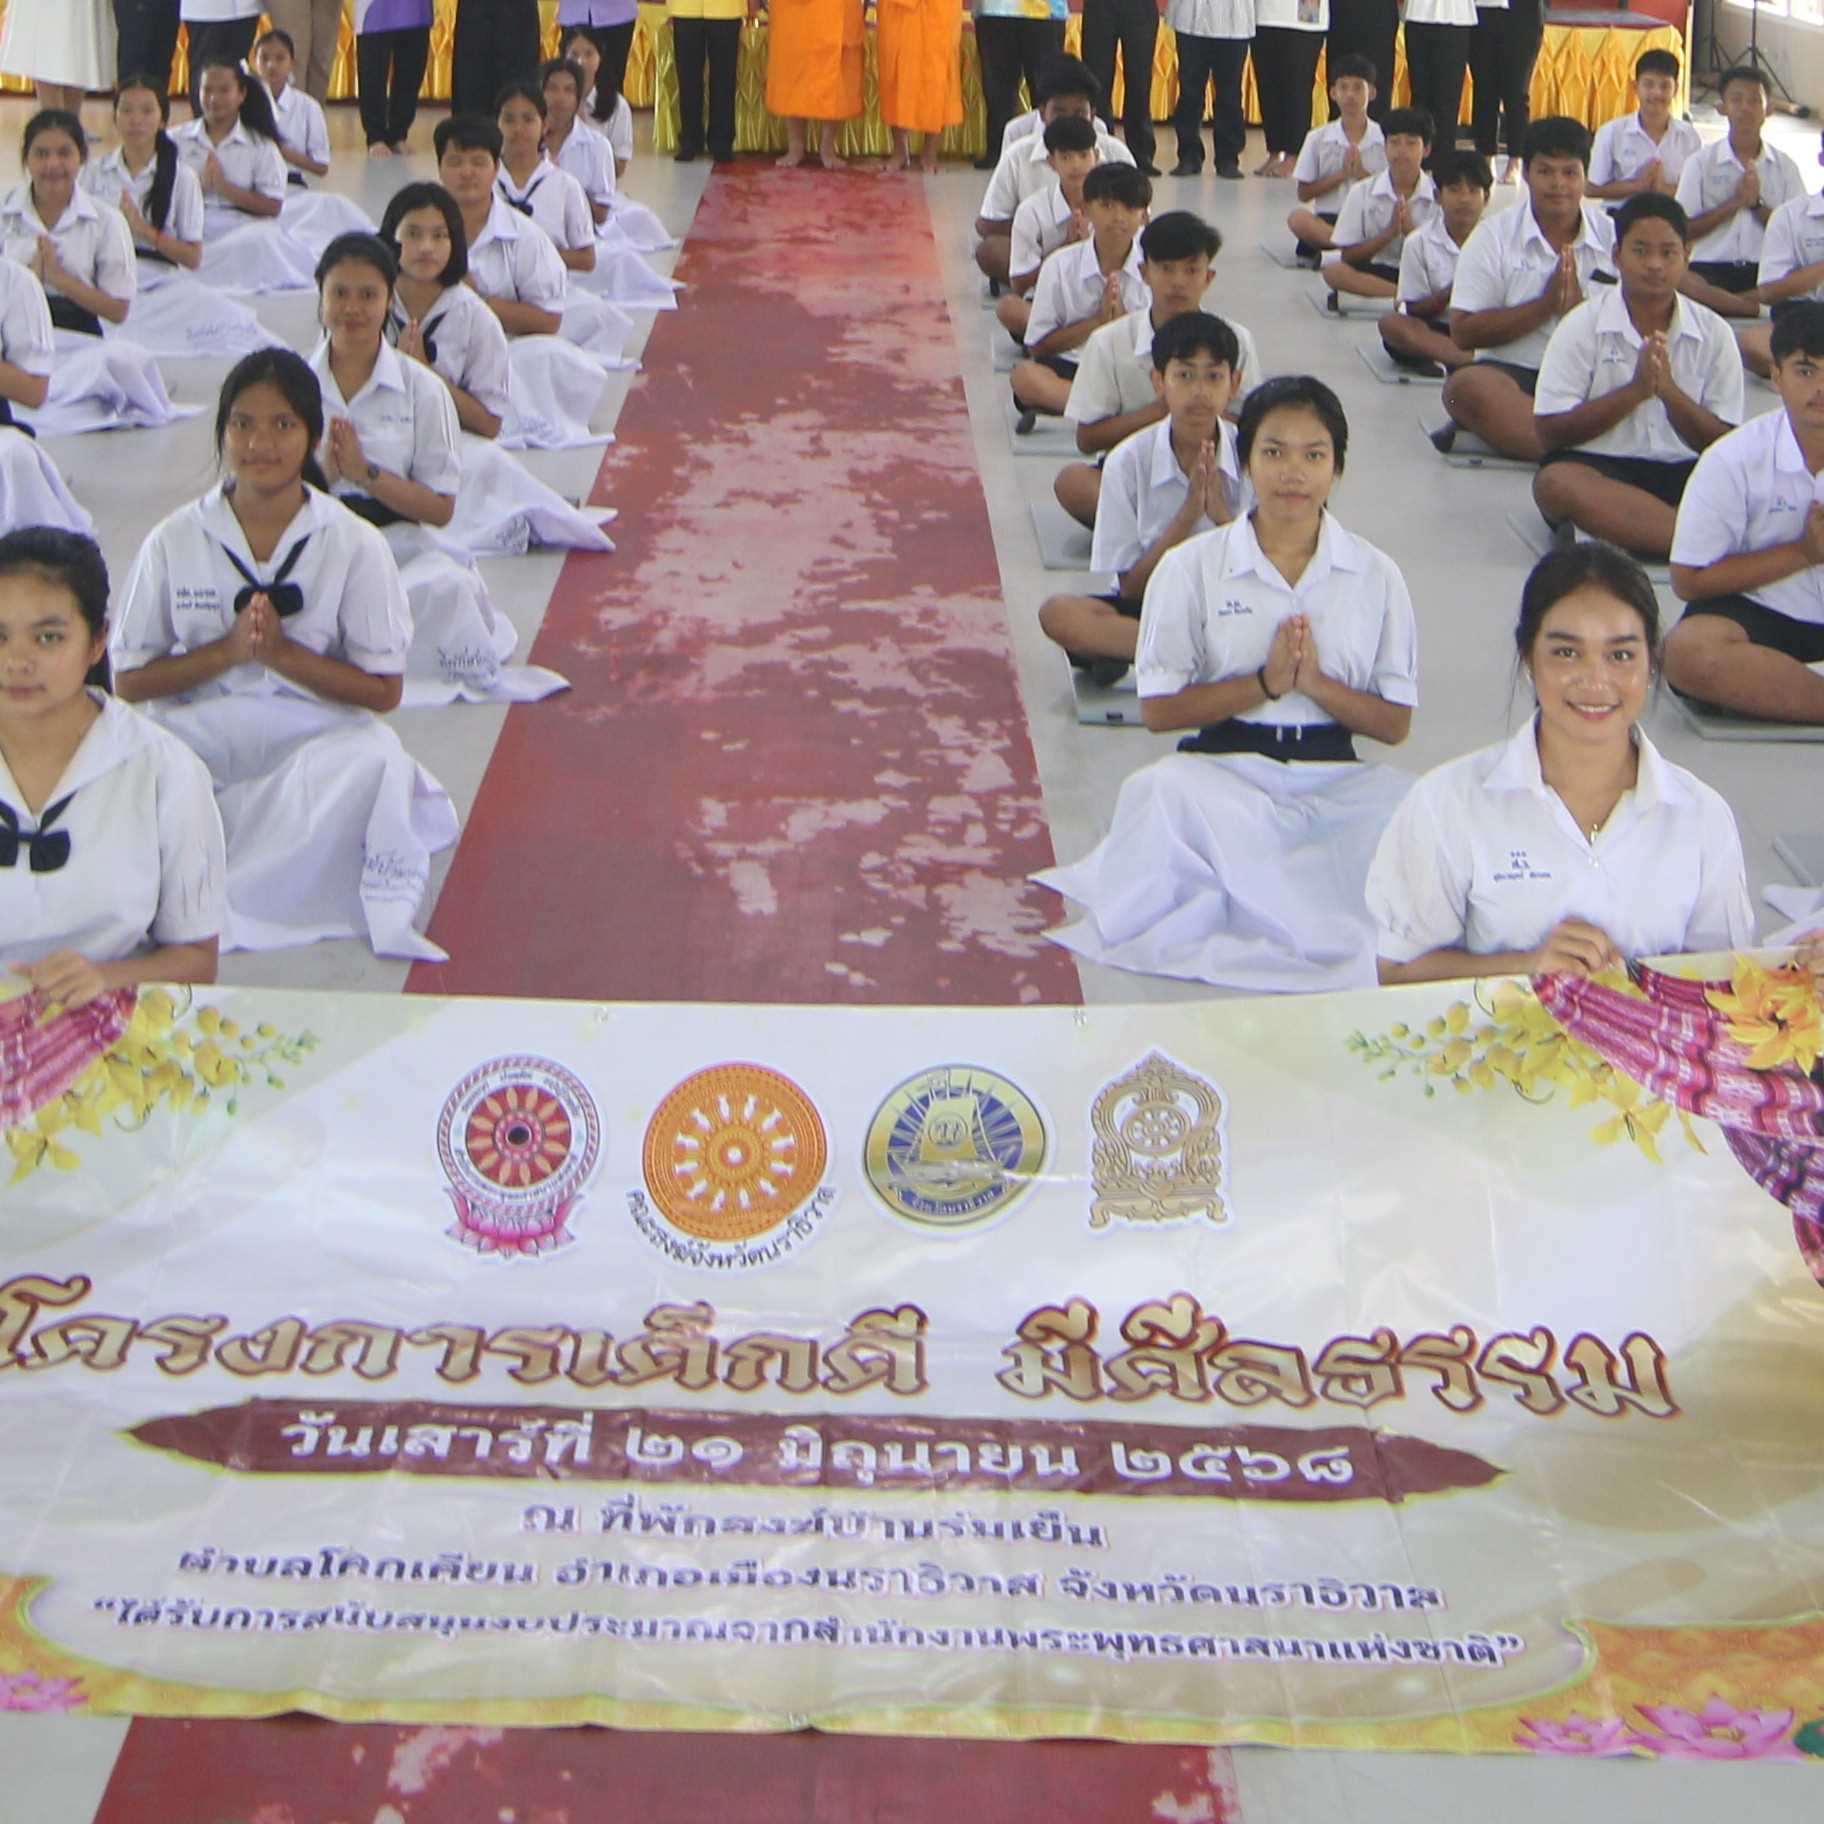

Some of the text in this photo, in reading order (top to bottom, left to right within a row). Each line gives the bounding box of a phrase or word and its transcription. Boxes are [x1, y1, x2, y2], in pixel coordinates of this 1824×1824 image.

[996, 1292, 1682, 1417] มีศีลธรรม
[282, 1411, 1353, 1484] วันเสาร์ที่ ๒๑ มิถุนายน ๒๕๖๘
[522, 1501, 576, 1533] ณ
[1057, 1567, 1444, 1609] จังหวัดนราธิวาส
